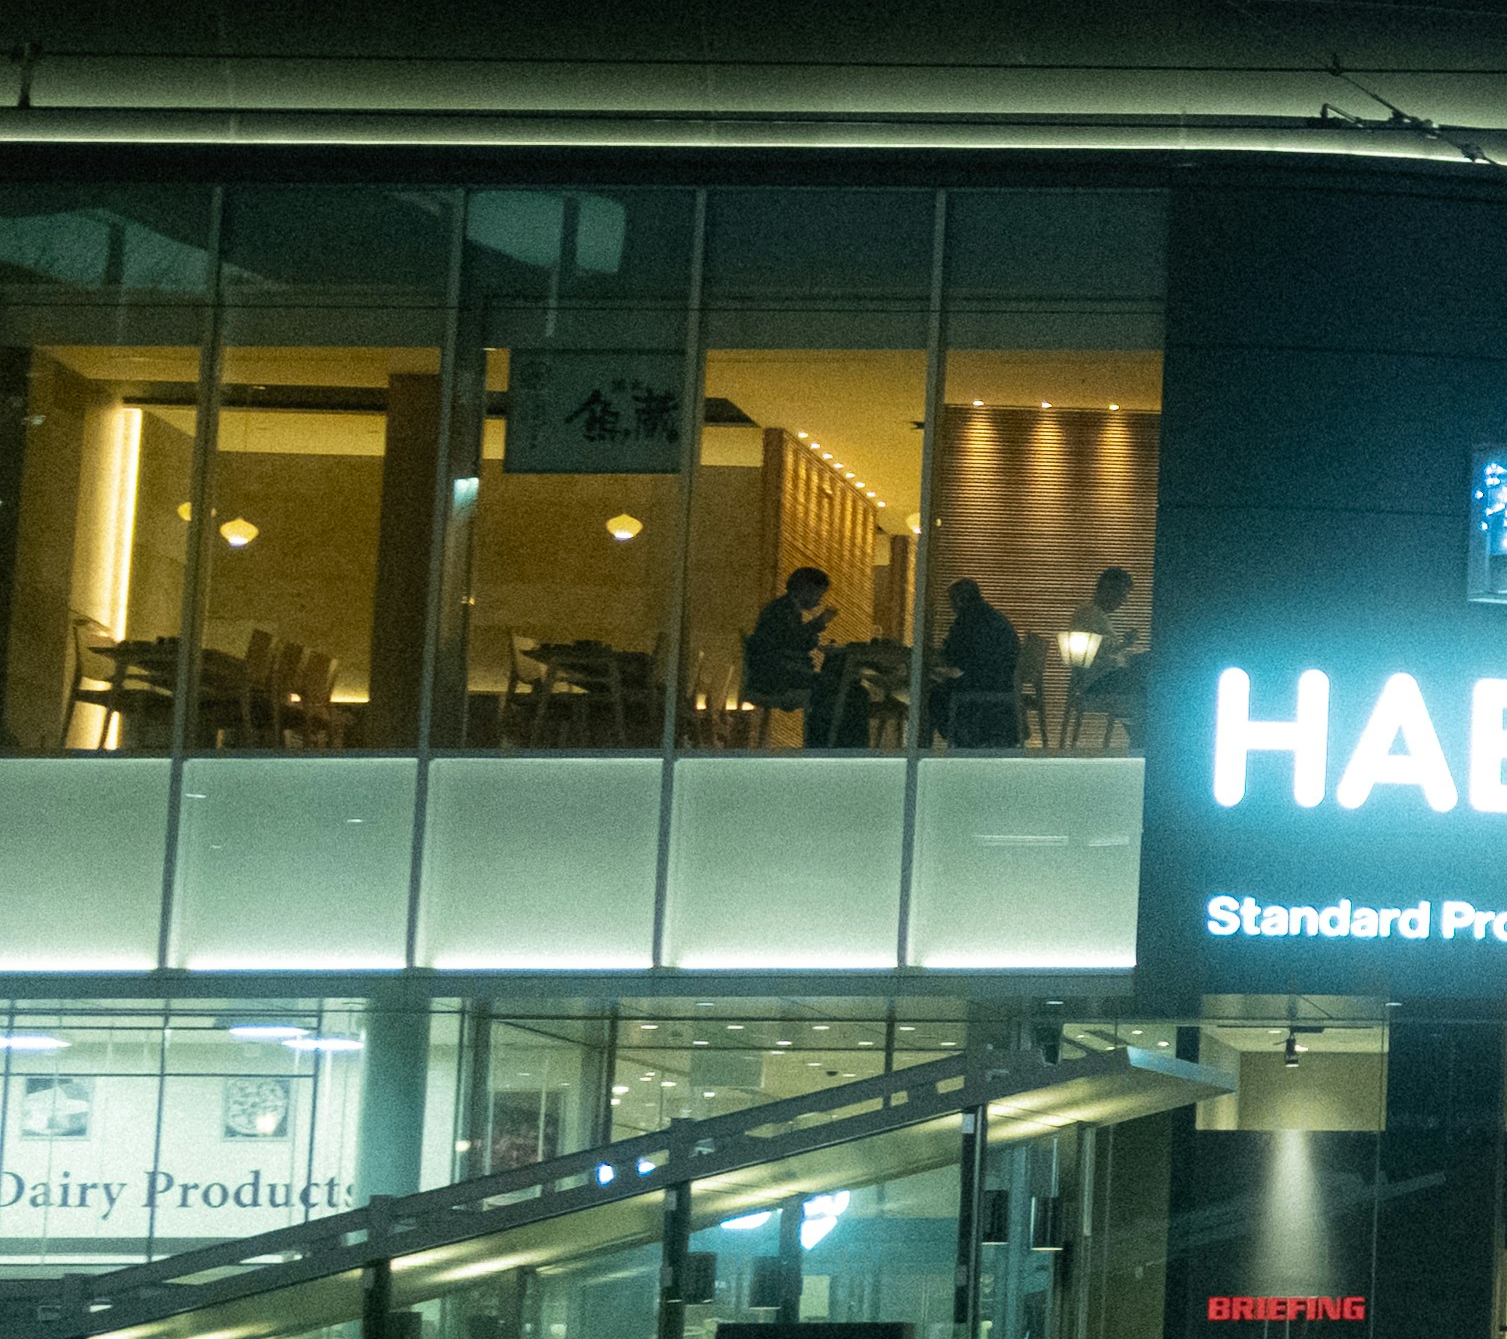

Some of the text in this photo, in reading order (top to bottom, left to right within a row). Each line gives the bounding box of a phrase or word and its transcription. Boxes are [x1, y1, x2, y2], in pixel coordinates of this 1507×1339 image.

[1206, 895, 1430, 940] Standard
[0, 1168, 357, 1223] Dairy Products
[1206, 1295, 1367, 1322] BRIEFING
